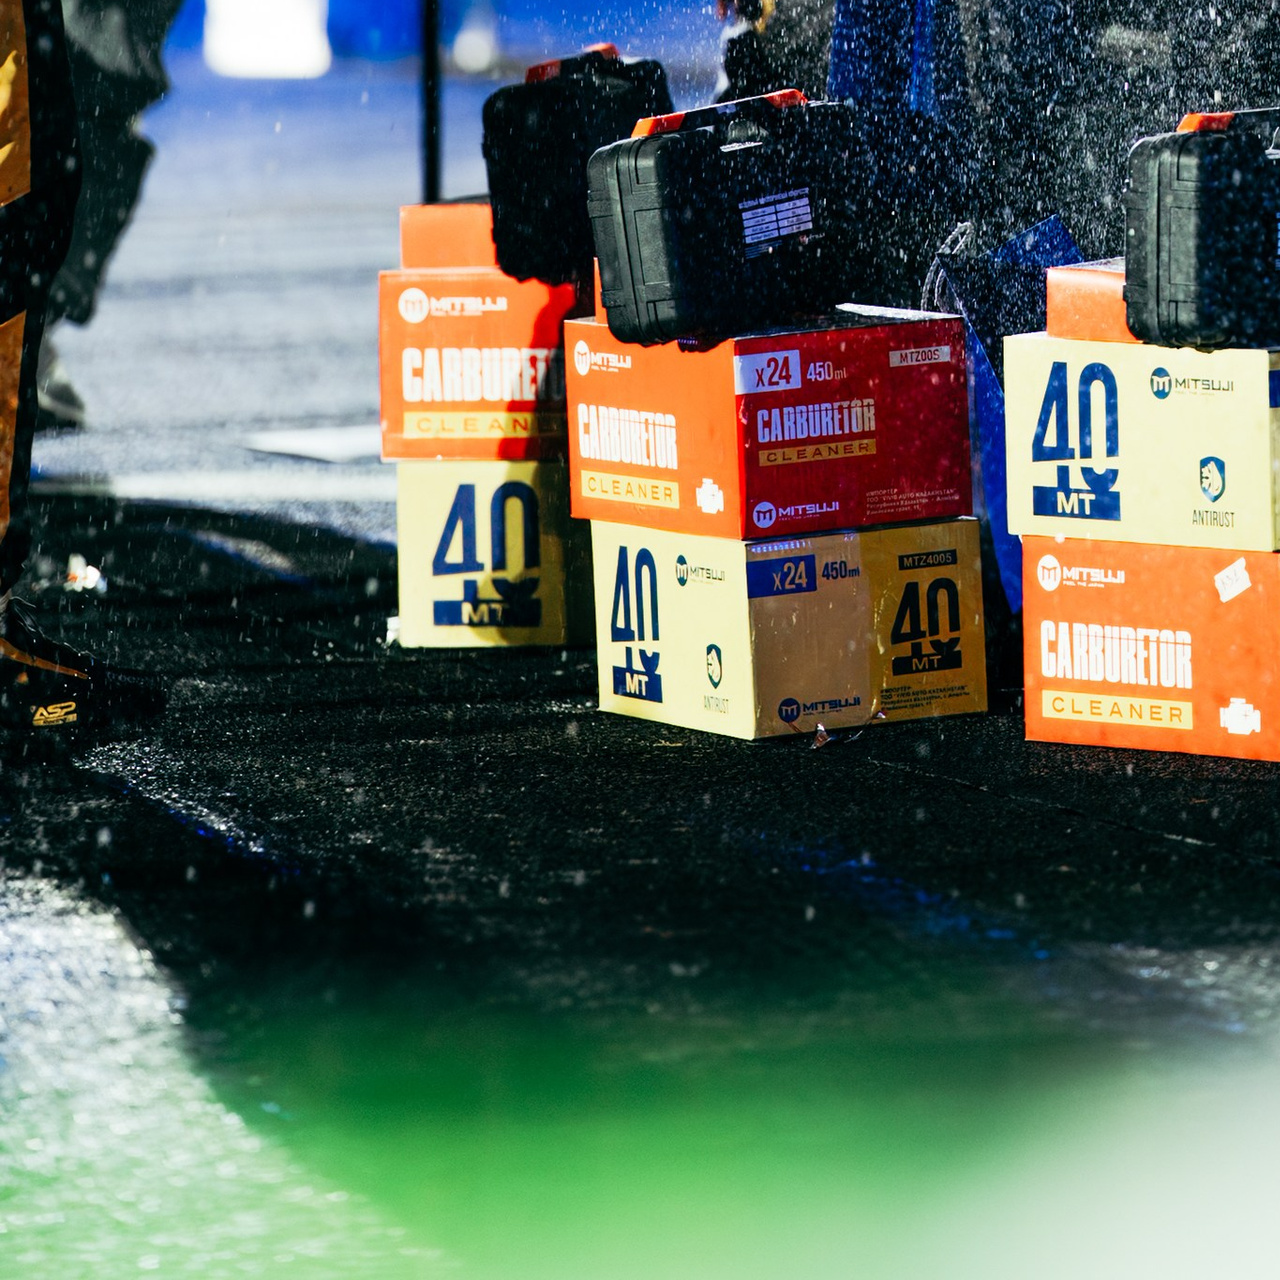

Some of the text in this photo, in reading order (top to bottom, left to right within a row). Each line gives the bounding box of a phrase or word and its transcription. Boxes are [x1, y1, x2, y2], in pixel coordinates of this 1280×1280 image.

[1175, 378, 1234, 392] MITSUJI
[416, 417, 529, 433] CLEAN
[757, 398, 876, 443] CARBURETOR
[1032, 361, 1119, 491] 40
[577, 403, 678, 470] CARBURETOR
[766, 443, 869, 462] CLEANER
[587, 476, 673, 502] CLEANER
[778, 502, 839, 517] MITSUJI
[1056, 492, 1096, 515] MT
[1192, 510, 1235, 528] ANTIRUST
[432, 480, 541, 600] 40
[903, 553, 953, 568] MTZ4005
[690, 566, 726, 582] MITSUJI
[1063, 567, 1125, 583] MITSUJI
[611, 545, 660, 672] 40
[891, 578, 961, 656] 40
[912, 655, 942, 671] MT
[1041, 620, 1192, 689] CARBURETOR
[625, 672, 649, 696] MT
[802, 697, 861, 713] MITSUJI
[1052, 696, 1183, 723] CLEANER
